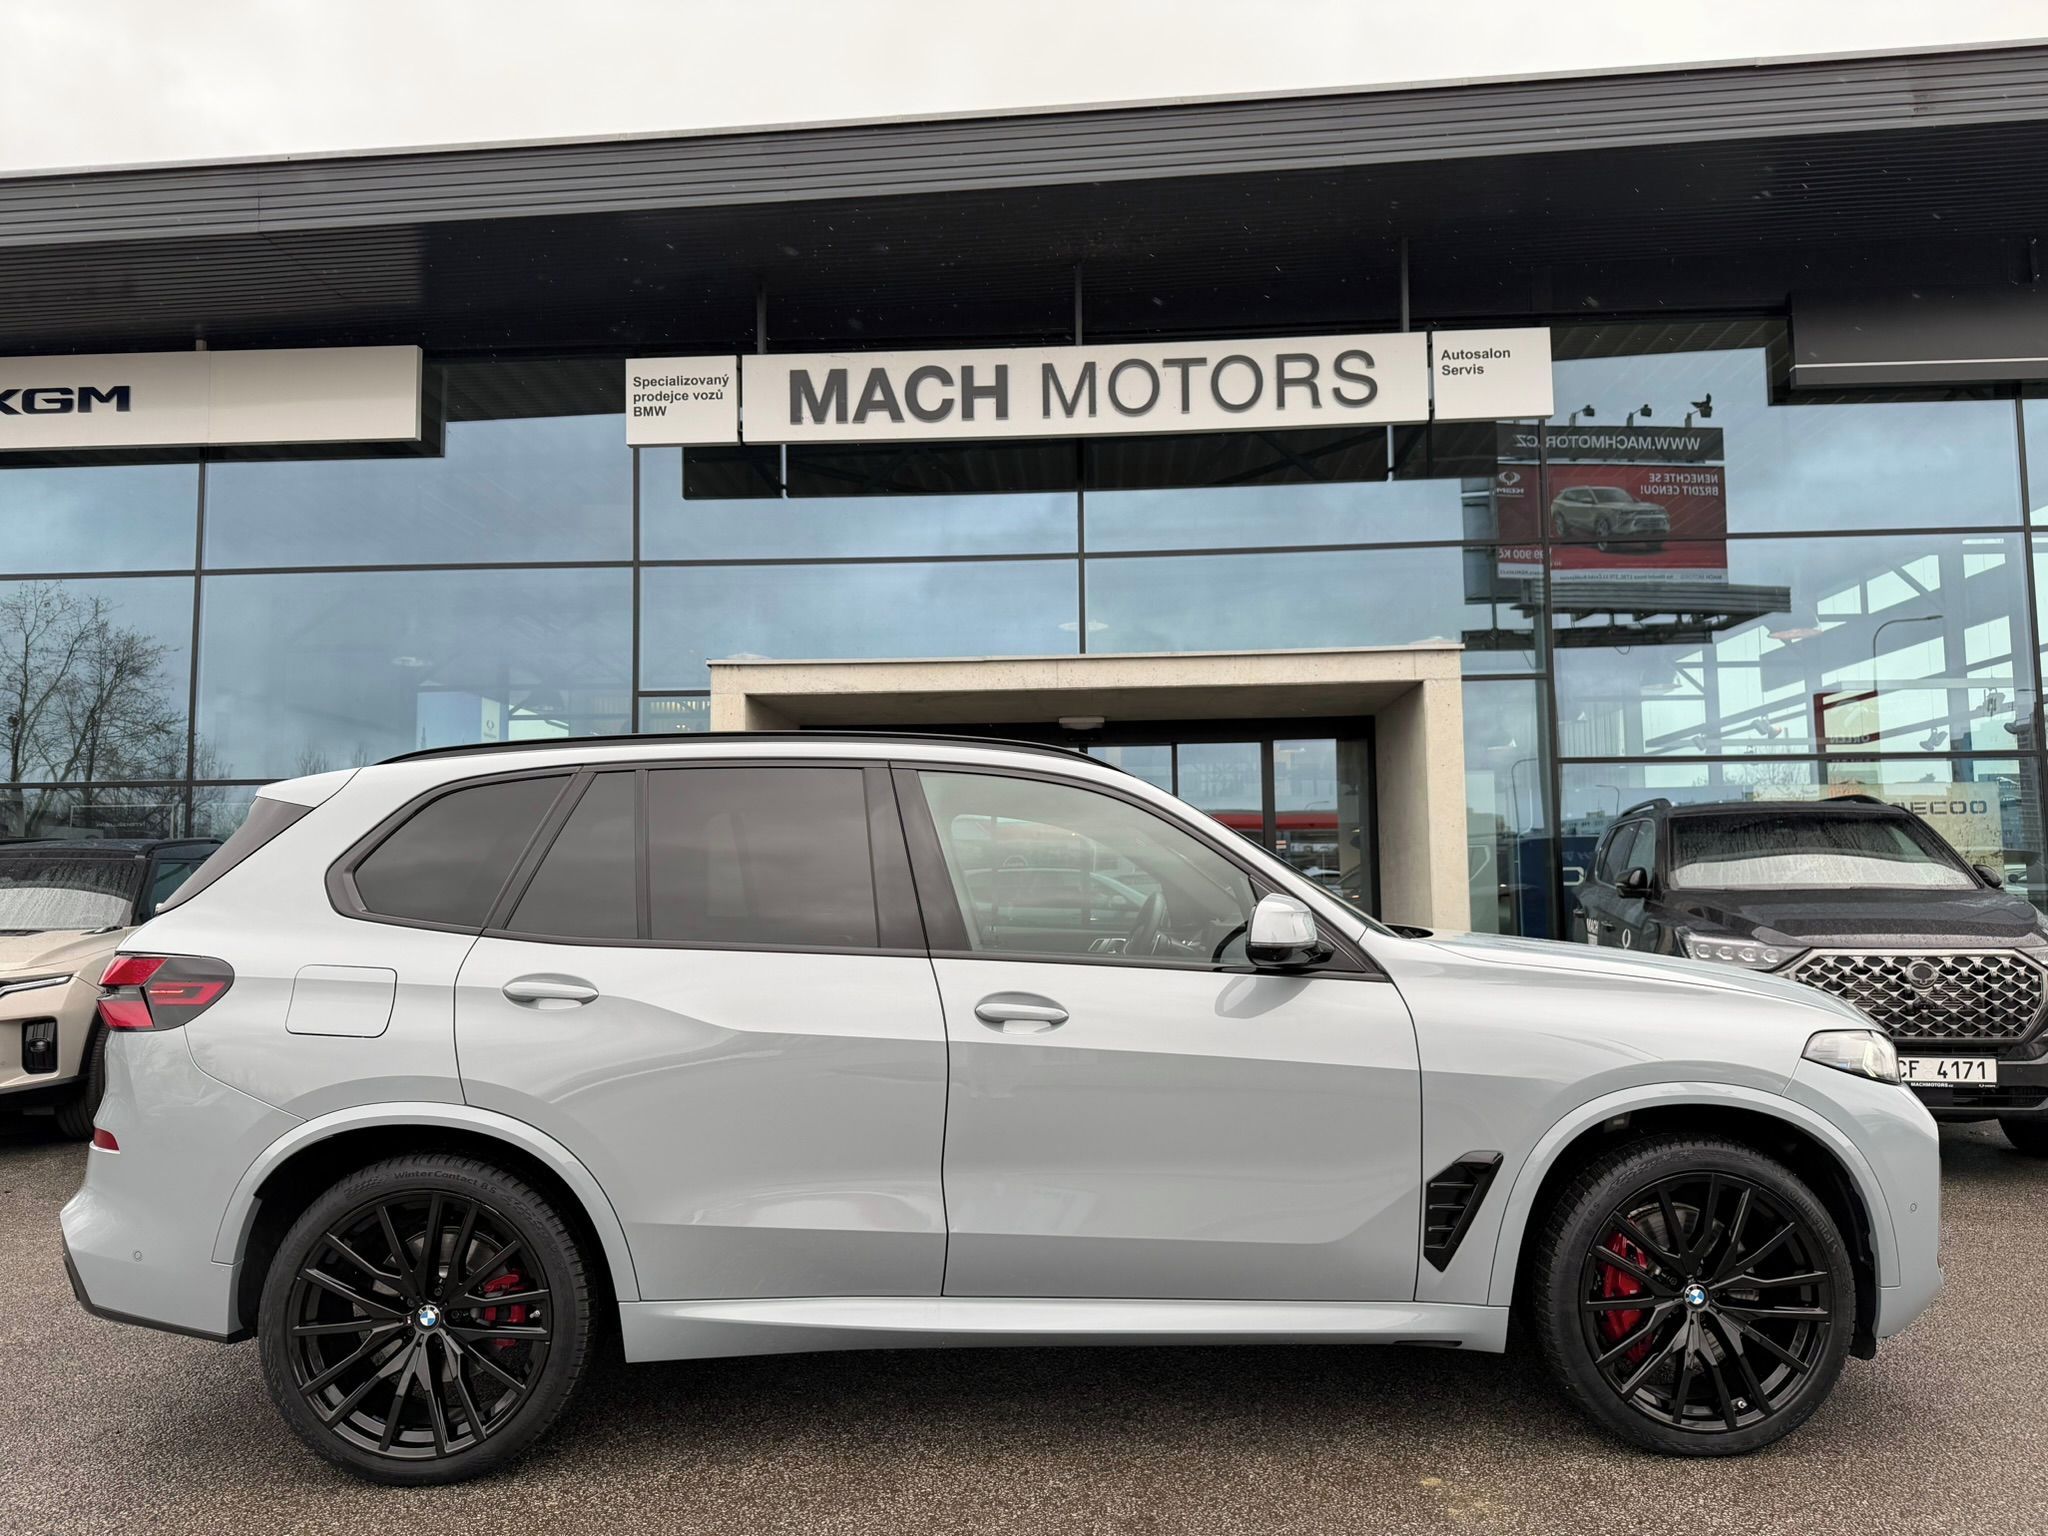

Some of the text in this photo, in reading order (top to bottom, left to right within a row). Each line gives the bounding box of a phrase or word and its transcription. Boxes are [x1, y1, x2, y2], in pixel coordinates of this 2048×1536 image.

[1440, 347, 1511, 361] Autosalon
[1441, 363, 1485, 376] Servis
[632, 373, 730, 388] Specializovaný
[789, 349, 1379, 426] MACH MOTORS
[0, 385, 131, 415] KGM
[632, 388, 724, 404] prodejce vozů
[633, 405, 667, 417] BMW
[1937, 1060, 1986, 1080] 4171
[394, 1170, 478, 1186] WinterContact
